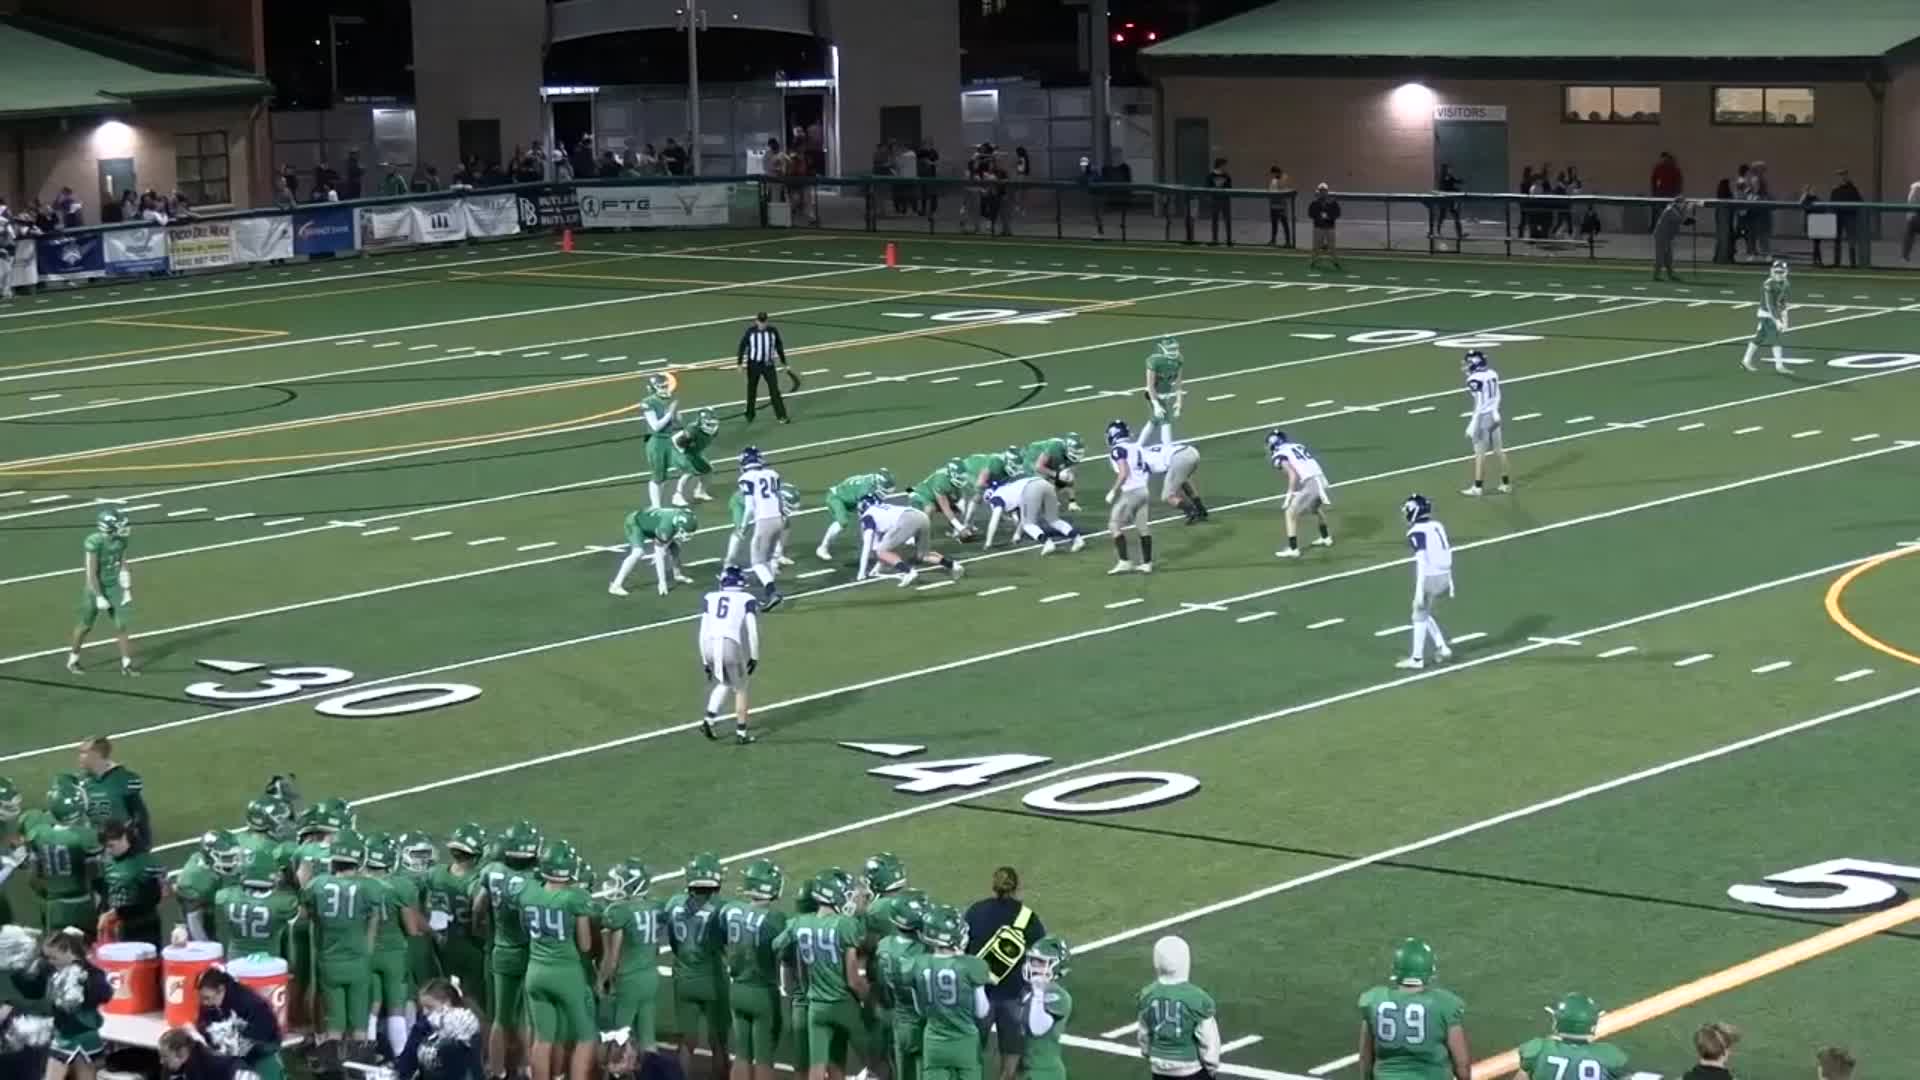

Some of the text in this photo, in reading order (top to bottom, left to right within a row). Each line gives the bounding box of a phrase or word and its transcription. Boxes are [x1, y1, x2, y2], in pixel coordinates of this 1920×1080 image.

[1437, 107, 1487, 118] VISITORS
[601, 199, 650, 211] FTG
[759, 476, 781, 499] 24
[1435, 527, 1447, 551] 1
[716, 596, 730, 619] 6
[184, 666, 484, 717] 30
[866, 753, 1202, 813] 40
[322, 882, 358, 919] 31
[228, 902, 271, 938] 42
[525, 905, 566, 941] 34
[671, 905, 712, 944] 67
[725, 907, 765, 946] 64
[796, 927, 838, 965] 84
[921, 967, 957, 1005] 19
[1150, 999, 1182, 1038] 14
[1376, 1000, 1426, 1045] 69
